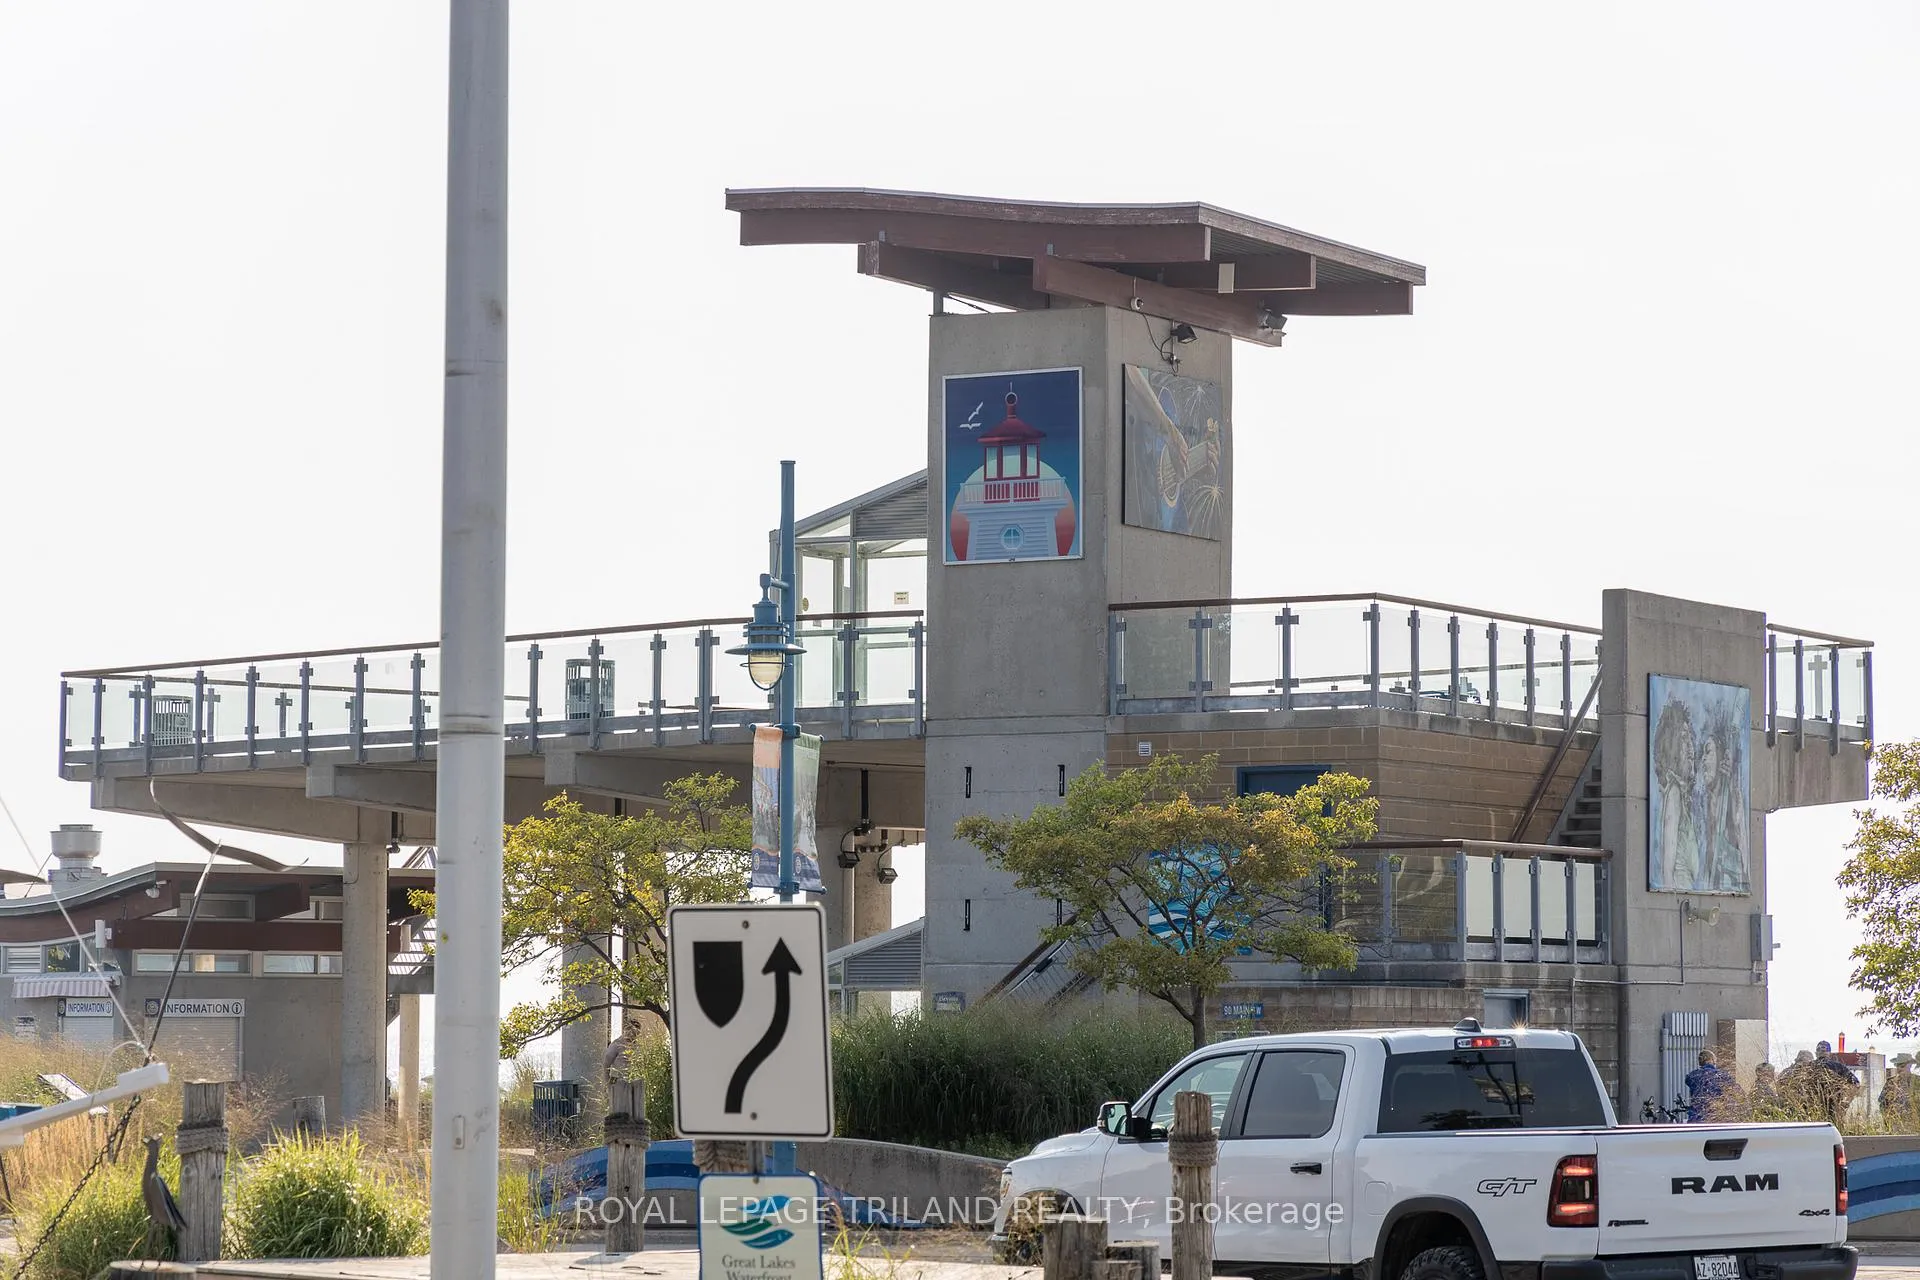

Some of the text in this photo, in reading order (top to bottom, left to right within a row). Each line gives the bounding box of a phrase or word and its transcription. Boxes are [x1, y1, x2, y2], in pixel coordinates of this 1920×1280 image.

[68, 1002, 105, 1013] INFORMATION
[1671, 1173, 1779, 1195] RAM
[721, 1254, 796, 1269] Great Lakes
